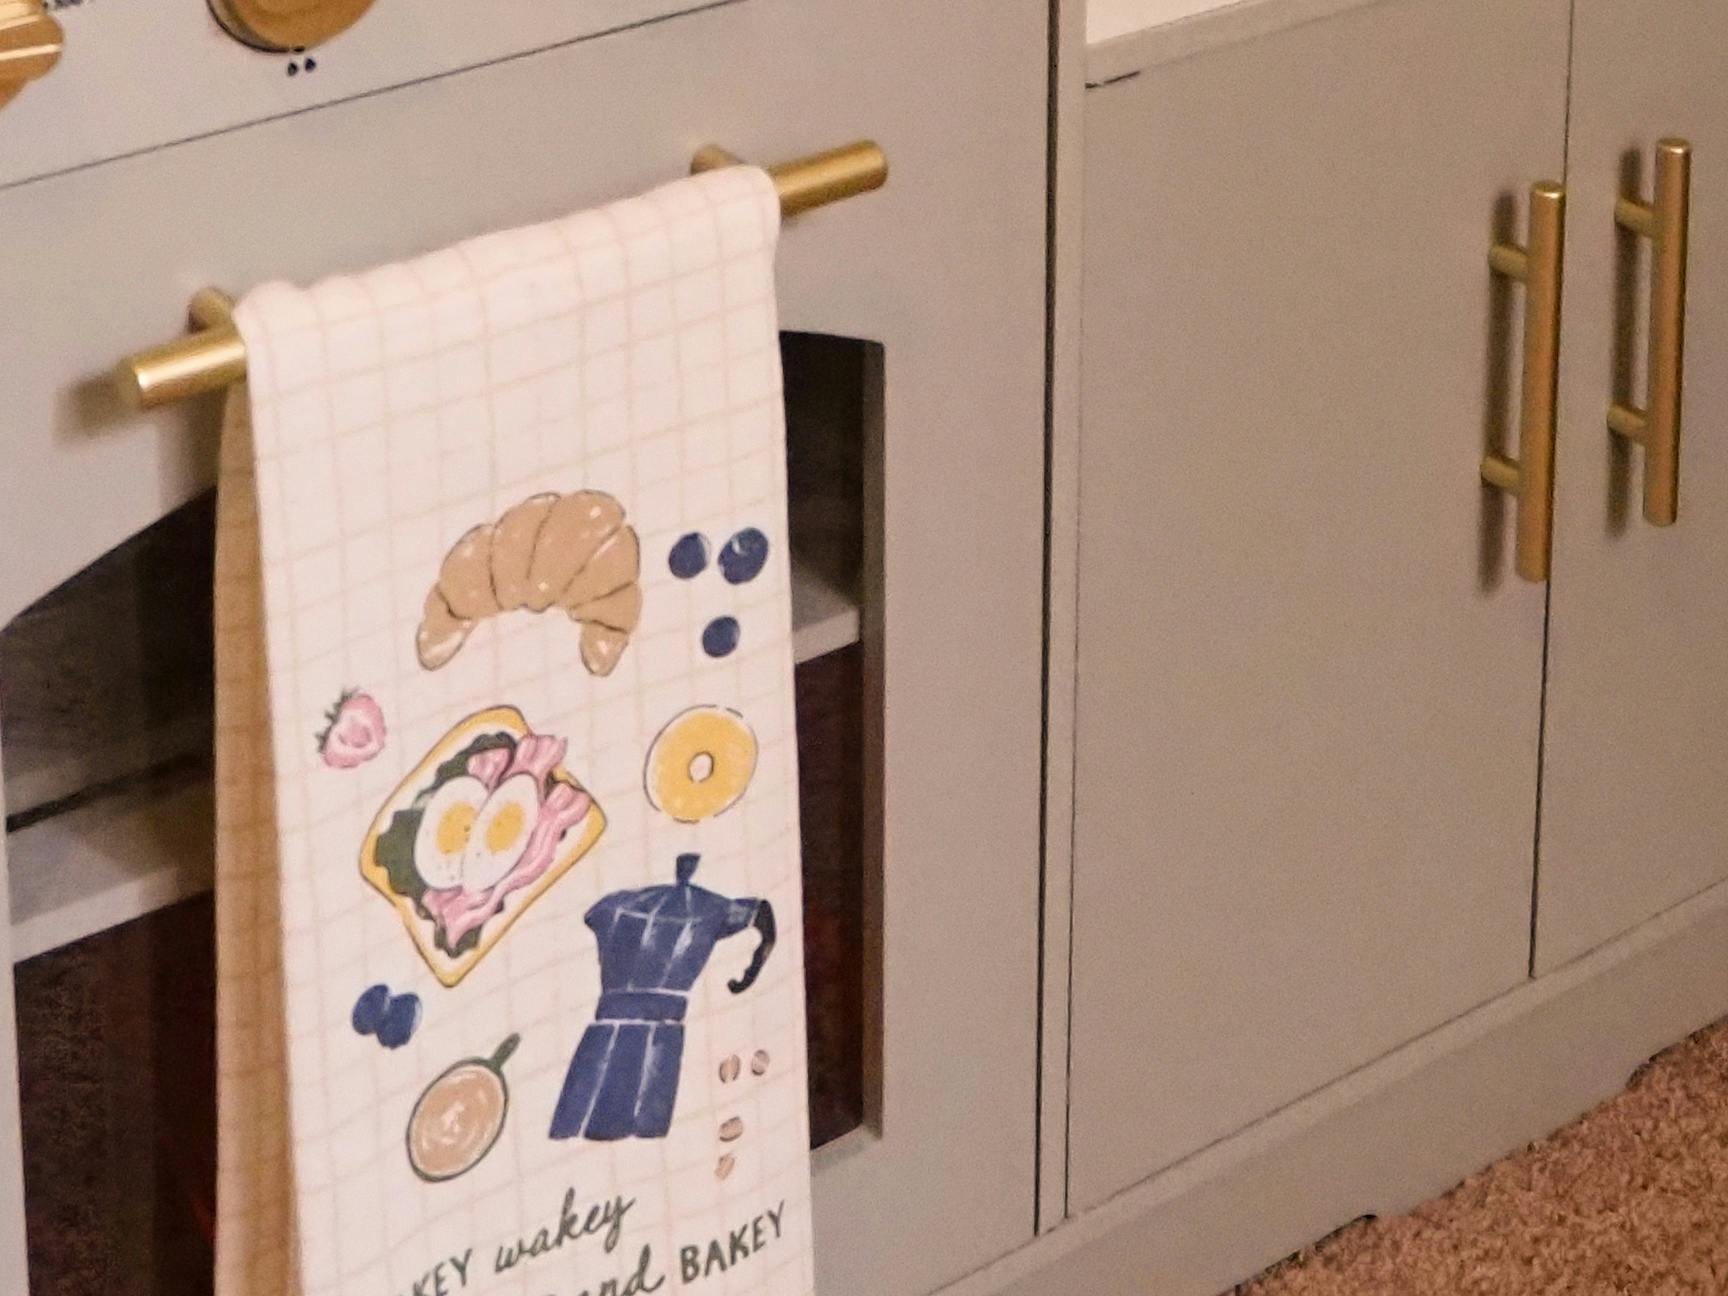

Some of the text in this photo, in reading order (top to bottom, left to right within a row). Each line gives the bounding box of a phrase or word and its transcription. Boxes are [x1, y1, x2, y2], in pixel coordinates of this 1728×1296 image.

[396, 1187, 636, 1296] KEY wakey
[680, 1199, 785, 1285] BAKEY
